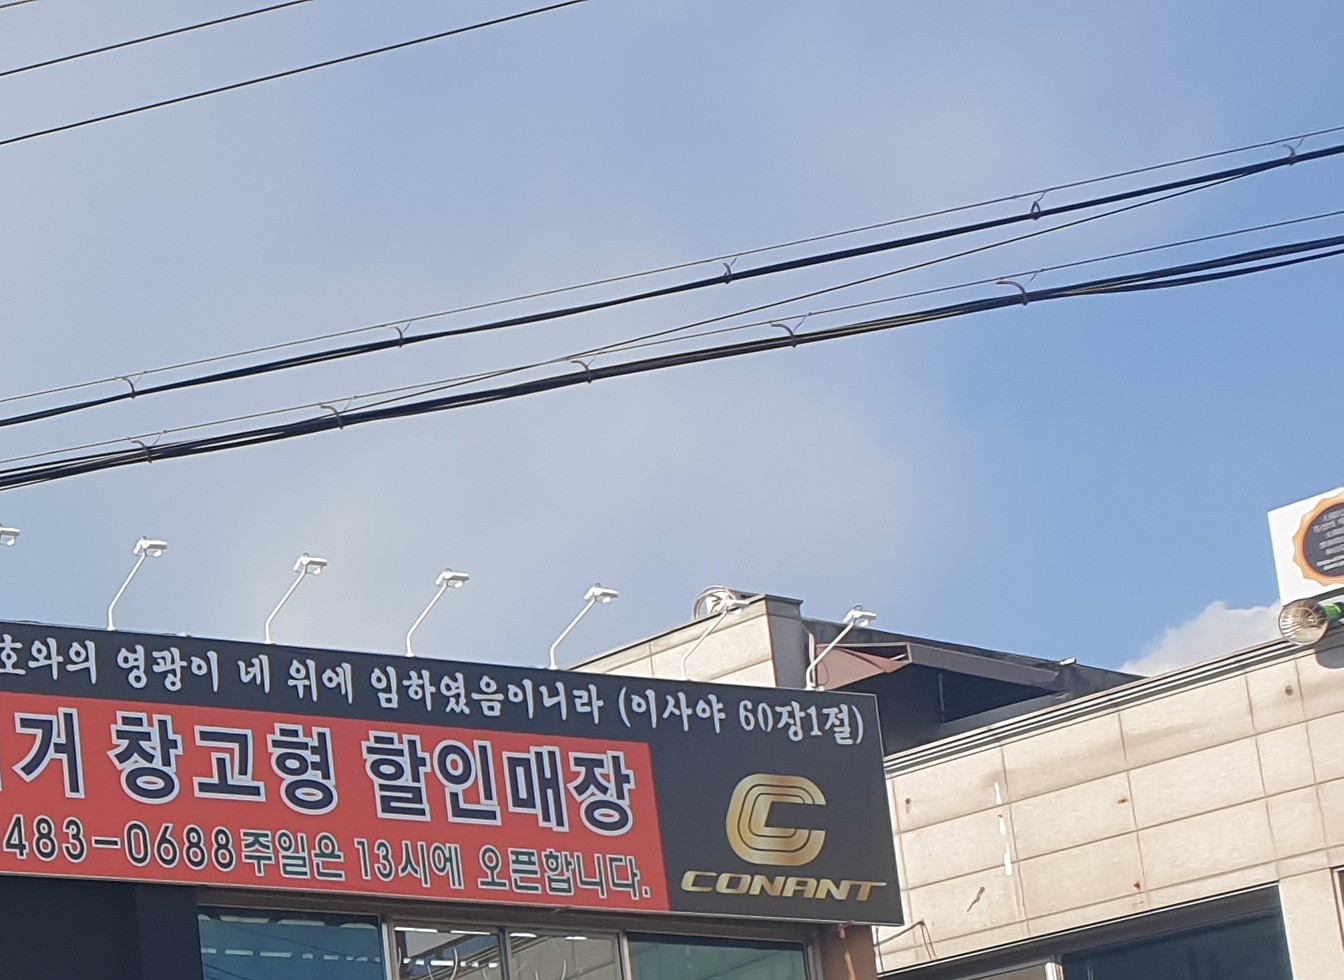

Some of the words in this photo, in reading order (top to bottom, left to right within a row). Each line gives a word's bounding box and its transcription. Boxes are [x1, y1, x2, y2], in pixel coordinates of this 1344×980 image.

[117, 645, 219, 693] 영광이
[236, 653, 272, 696] 네
[287, 657, 354, 706] 위에
[369, 665, 606, 726] 임하였음이니라
[617, 689, 727, 735] (이사야
[738, 700, 865, 748] 60장1절)
[108, 710, 339, 816] 창고형
[362, 728, 636, 838] 할인매장
[241, 827, 346, 882] 주일은
[355, 836, 462, 891] 13시에
[478, 846, 652, 901] 오픈합니다.
[681, 869, 887, 902] CONANT
